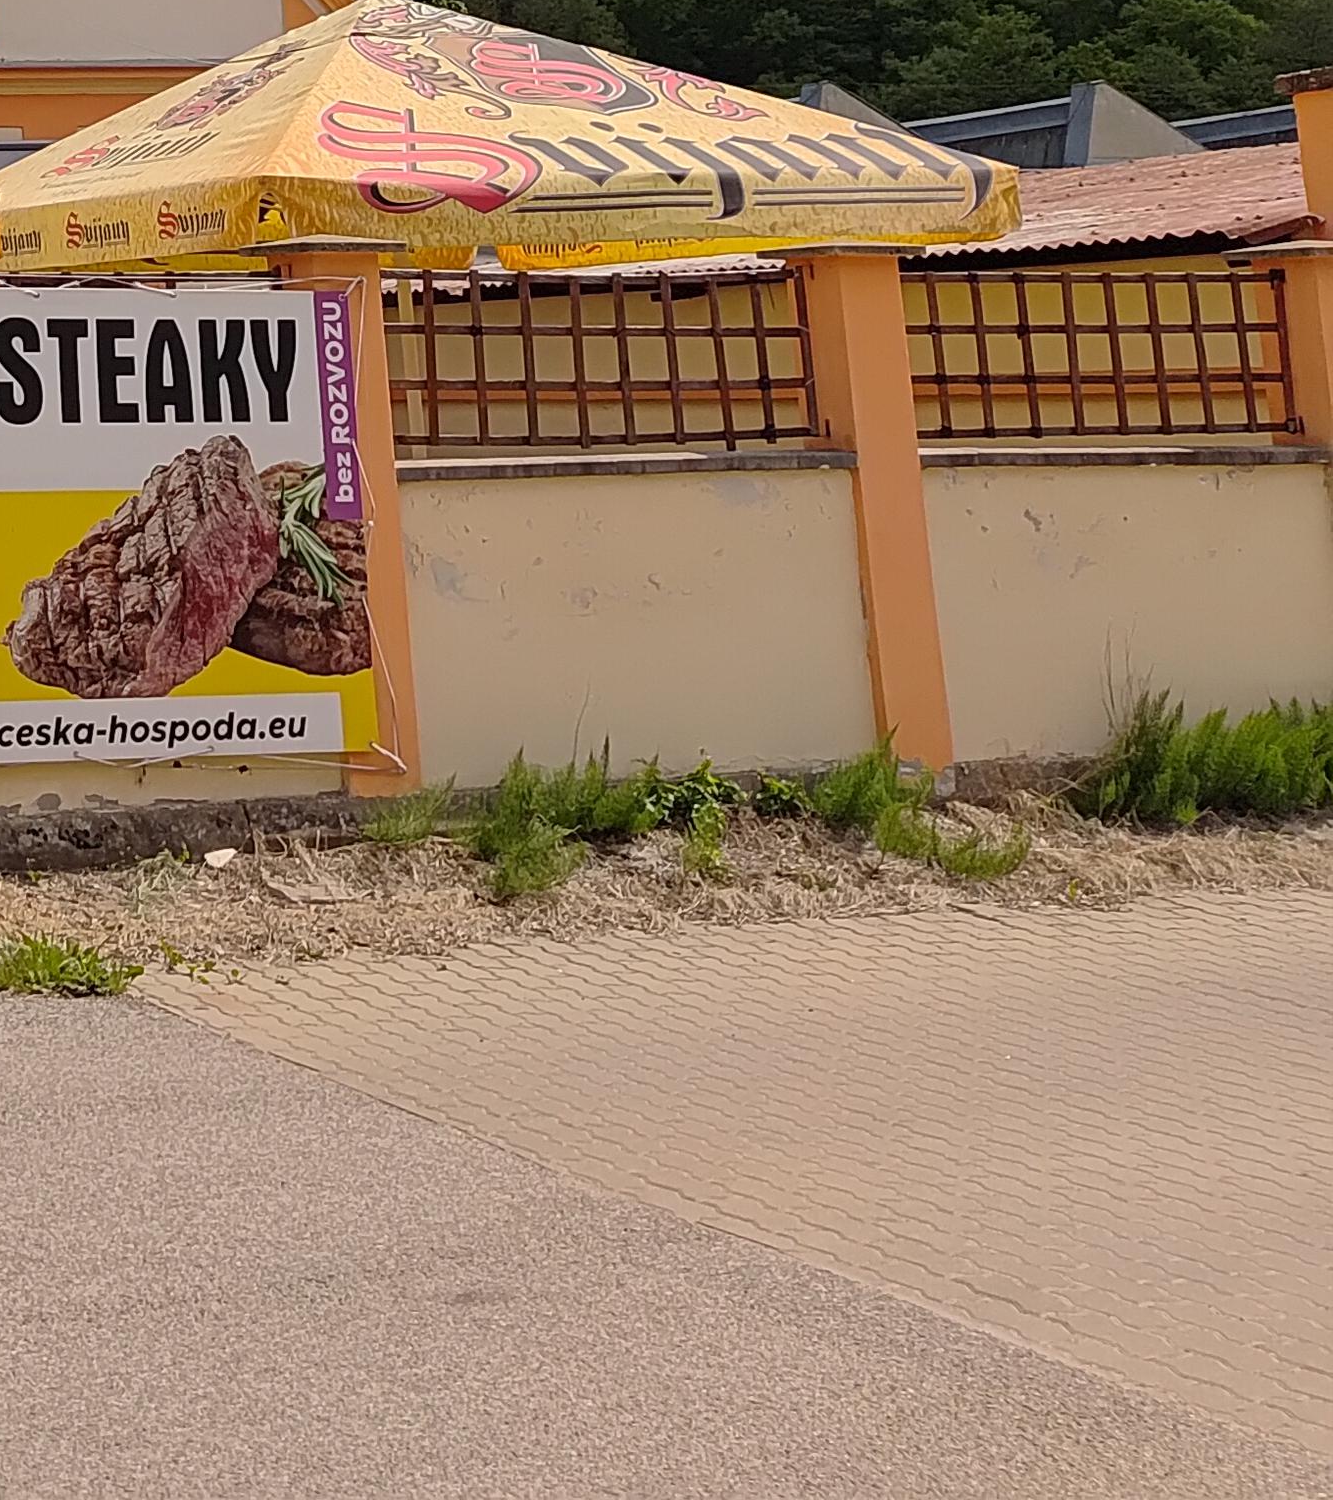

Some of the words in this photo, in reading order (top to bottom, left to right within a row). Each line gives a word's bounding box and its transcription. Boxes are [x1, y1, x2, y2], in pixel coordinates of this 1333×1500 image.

[319, 100, 992, 221] Svijany
[65, 211, 130, 249] Svijany
[157, 200, 227, 239] Svijany
[0, 228, 42, 257] vijany
[321, 301, 351, 445] ROZVOZU
[334, 452, 354, 504] bez
